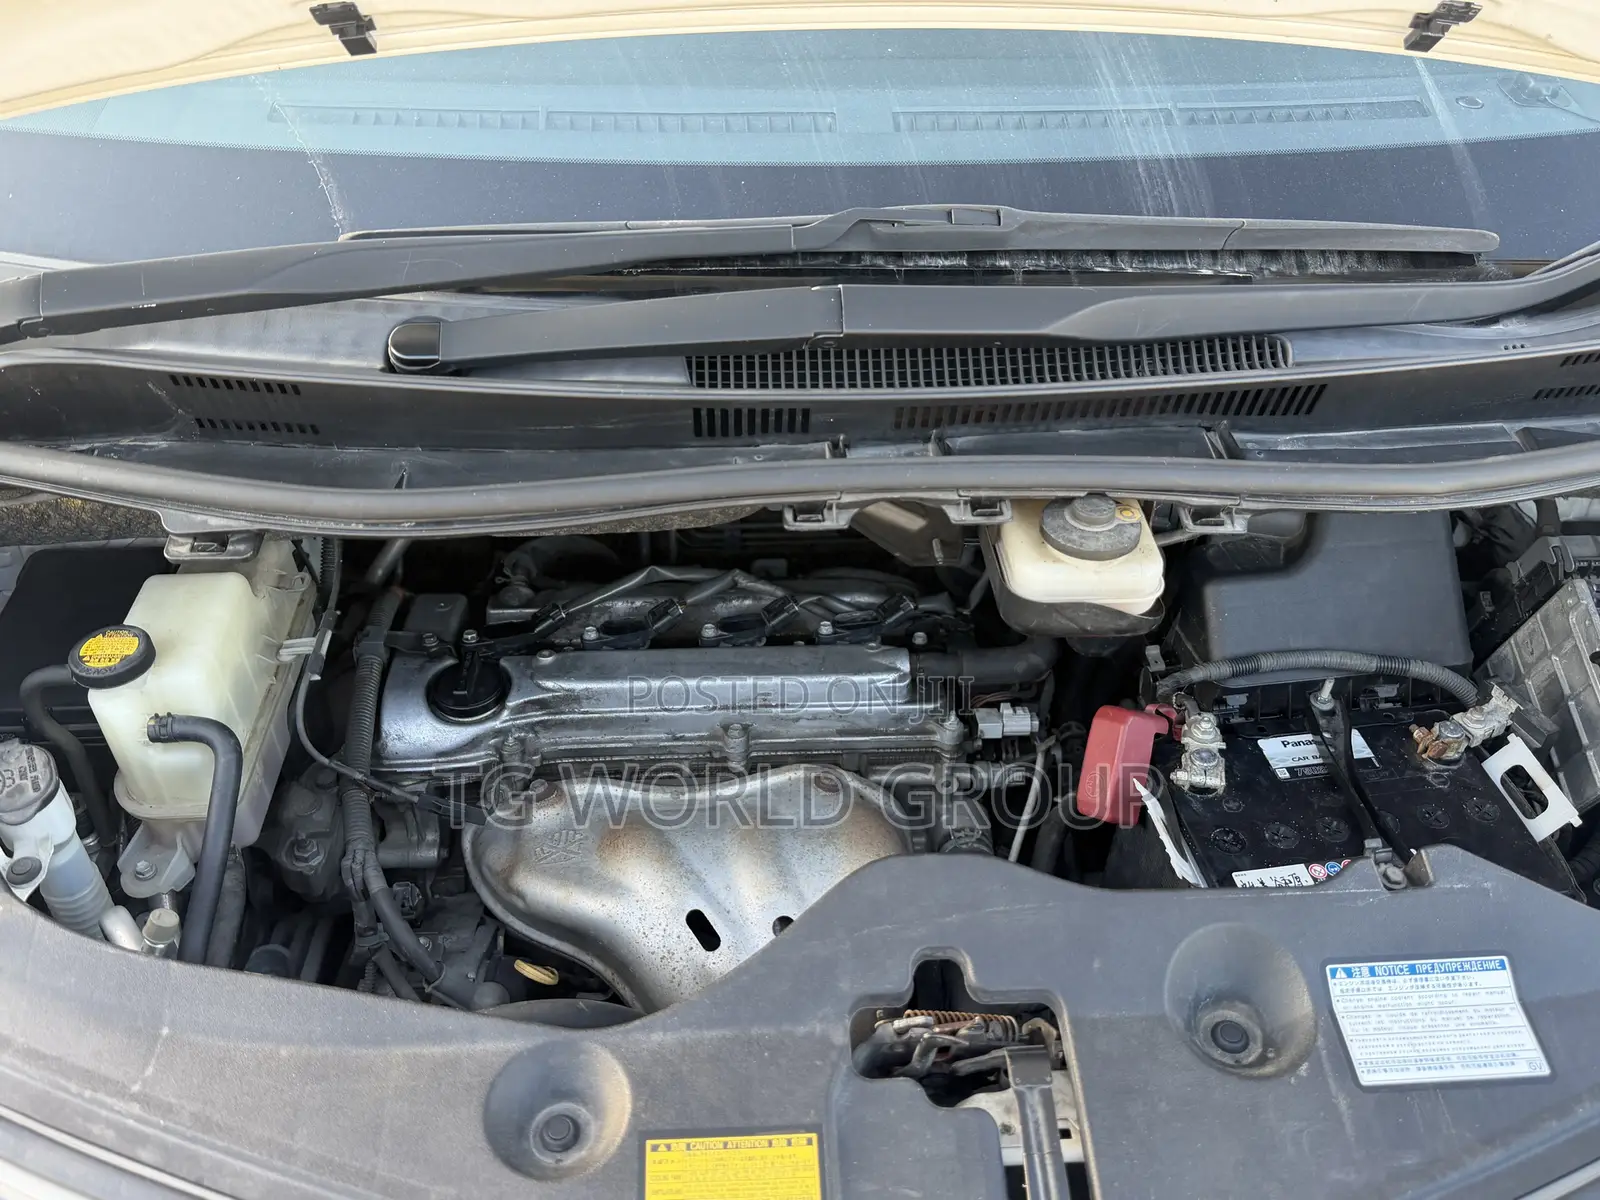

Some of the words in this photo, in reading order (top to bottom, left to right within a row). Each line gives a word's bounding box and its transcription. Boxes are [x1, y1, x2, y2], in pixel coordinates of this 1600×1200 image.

[1374, 964, 1411, 976] NOTICE
[1415, 960, 1502, 974] ПРЕДУПРЕЖДЕНИЕ
[690, 1141, 723, 1150] CAUTION
[727, 1139, 768, 1150] ATTENTION
